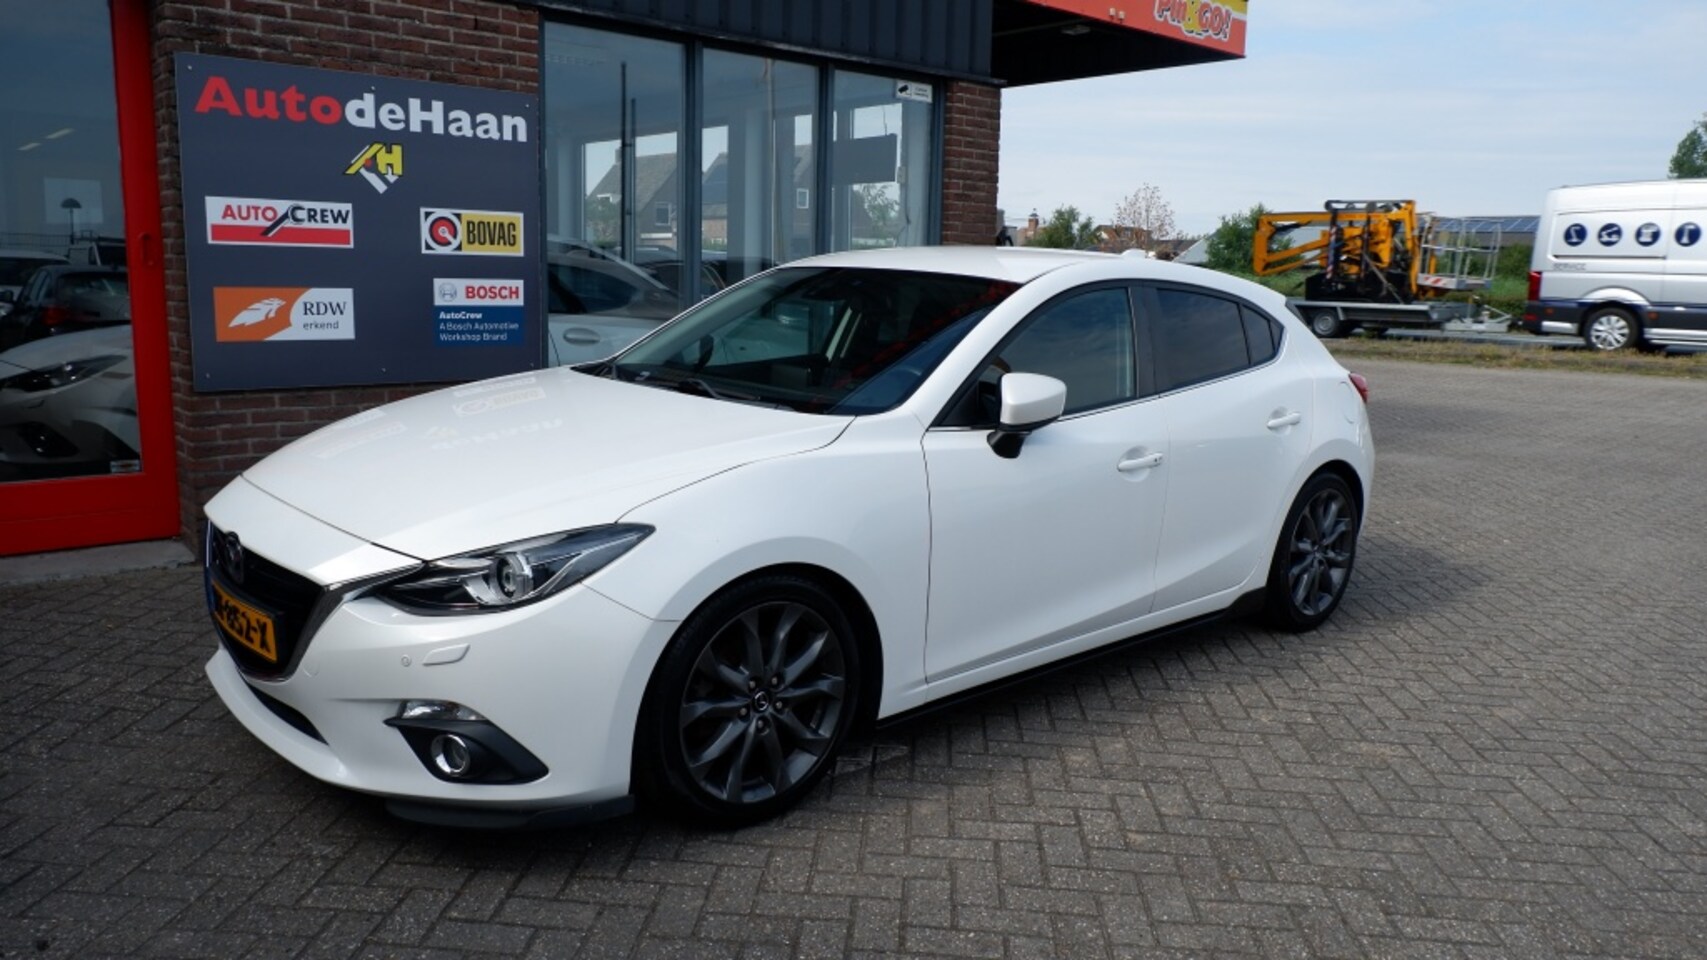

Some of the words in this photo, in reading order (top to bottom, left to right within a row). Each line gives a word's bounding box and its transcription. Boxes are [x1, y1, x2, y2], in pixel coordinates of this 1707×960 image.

[221, 204, 278, 222] AUTO
[289, 205, 350, 224] CREW
[466, 220, 517, 247] BOVAG
[465, 285, 520, 300] BOSCH
[302, 301, 347, 316] RDW
[439, 311, 483, 320] AutoCrew
[302, 321, 340, 330] erkend
[439, 322, 446, 330] A
[446, 322, 473, 331] Bosch
[473, 322, 520, 331] Automotive
[439, 333, 482, 342] Workshop
[482, 333, 508, 341] Brand
